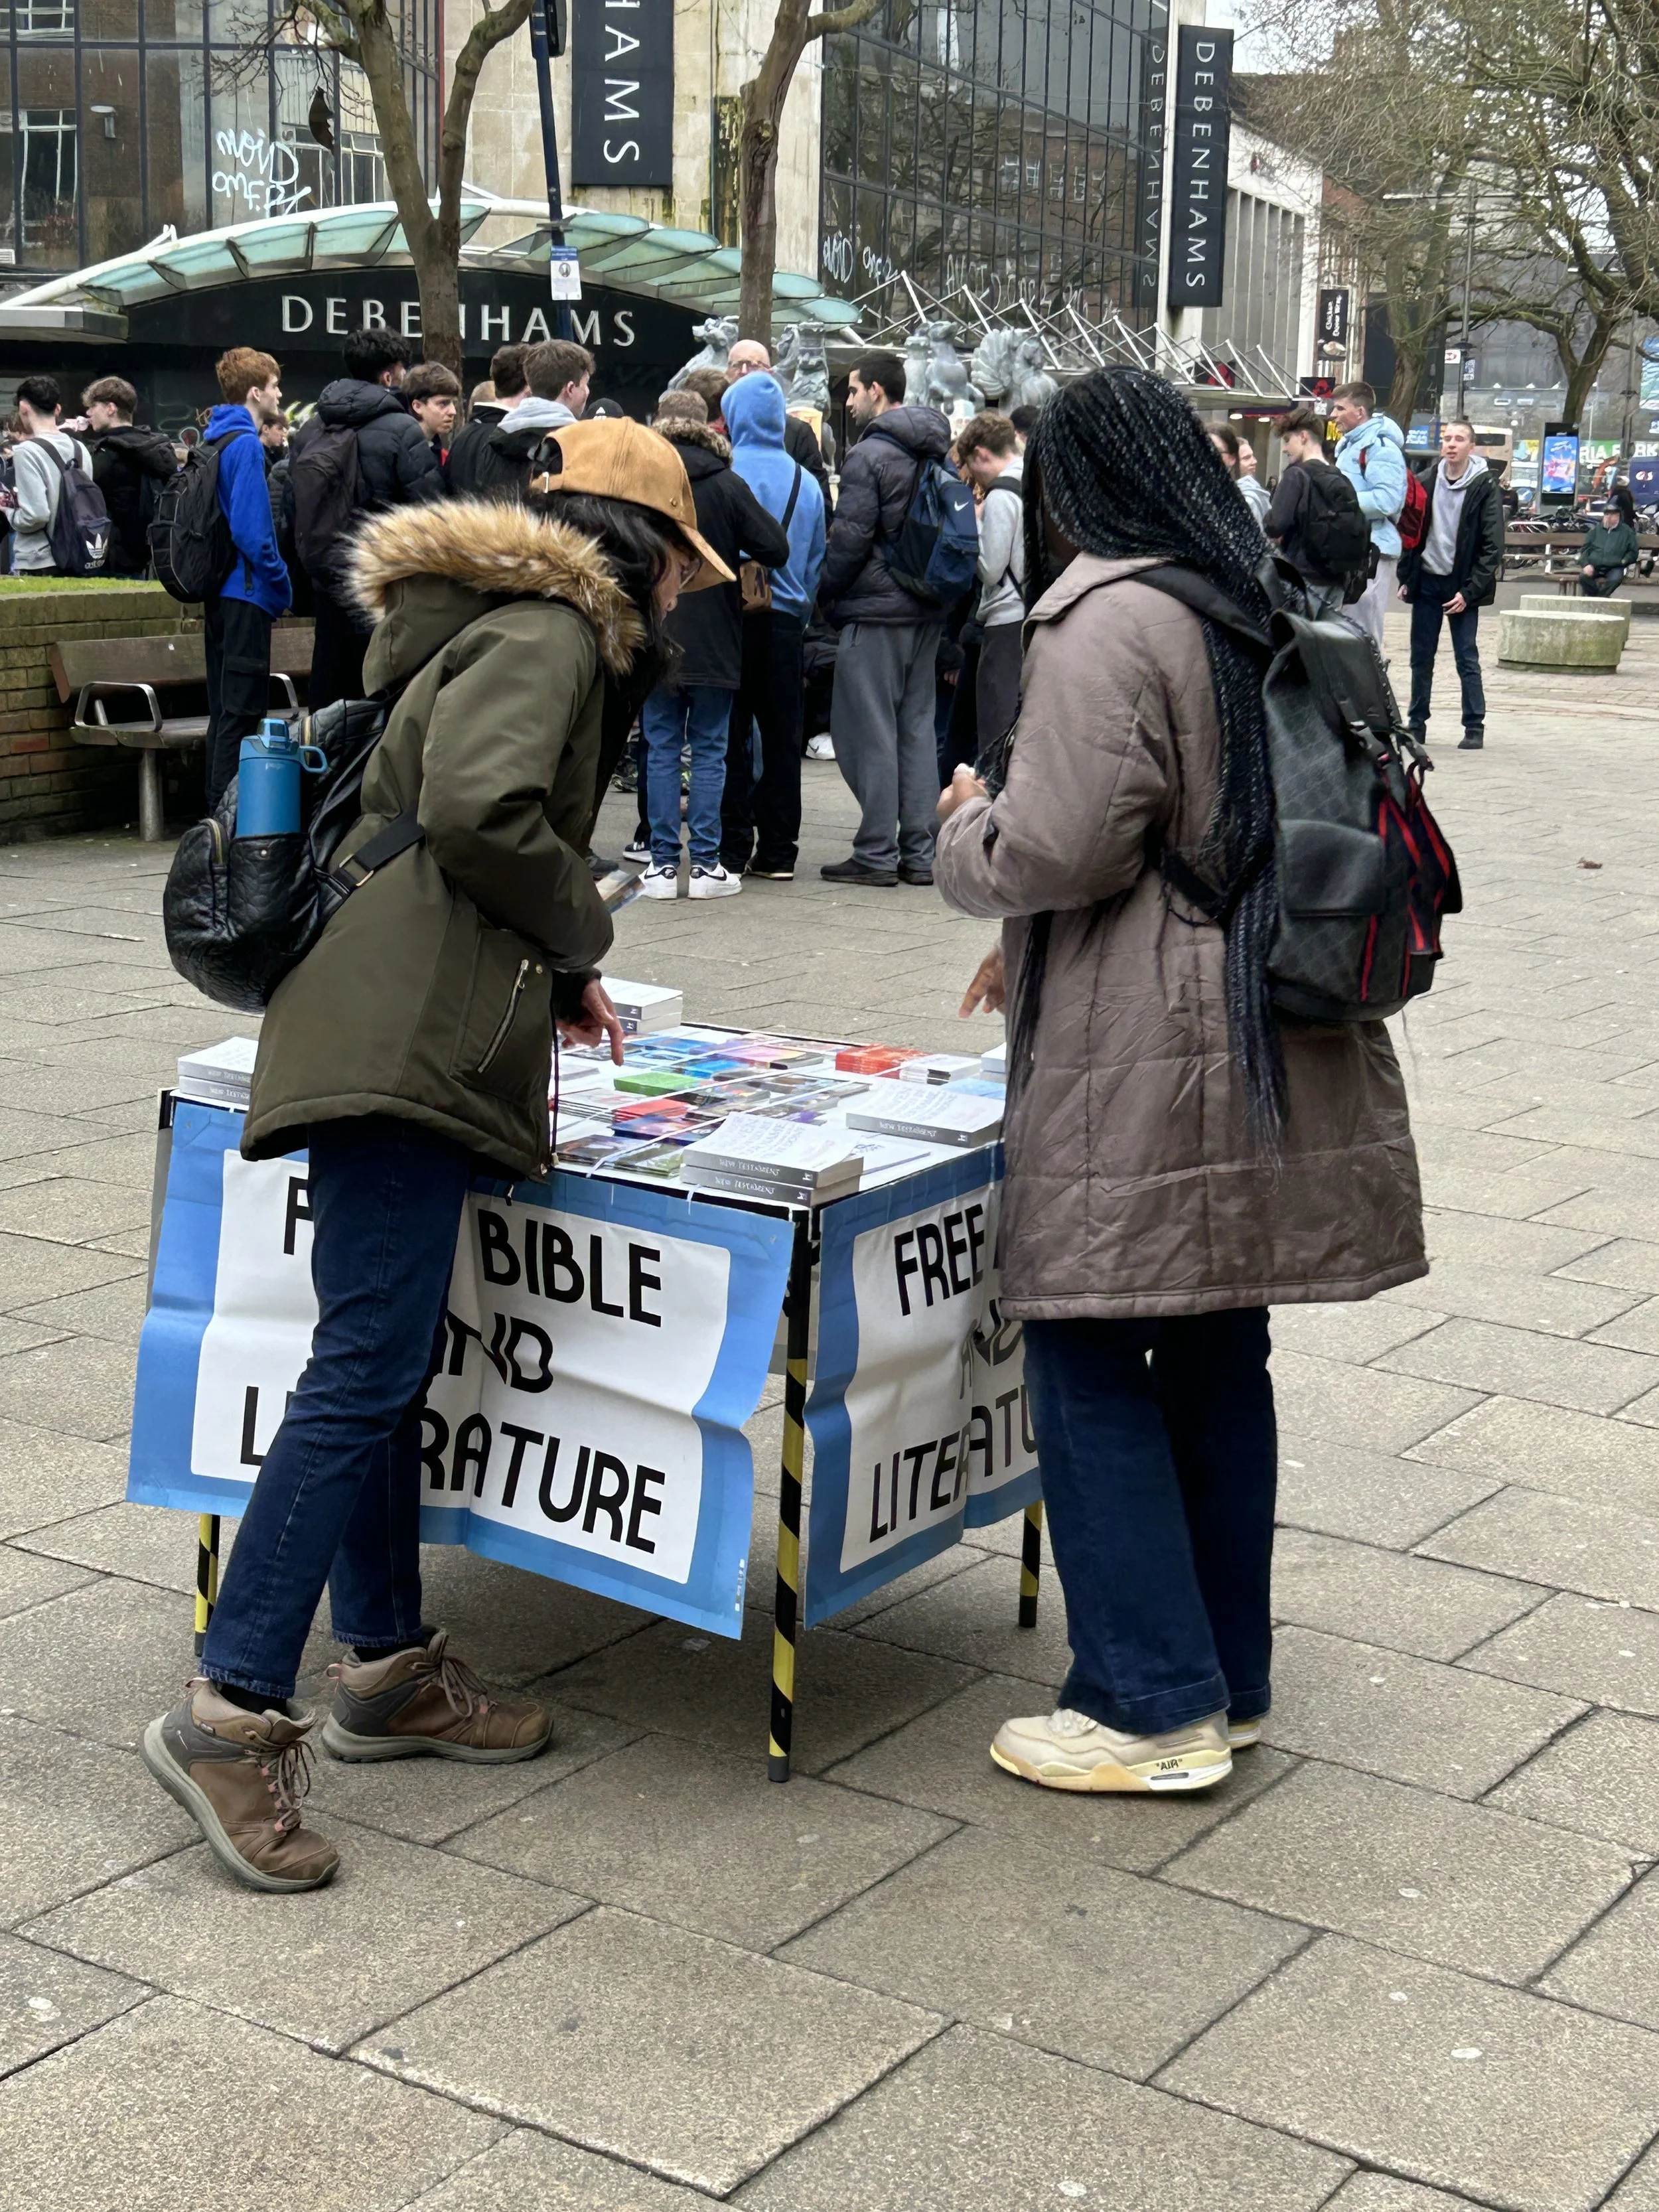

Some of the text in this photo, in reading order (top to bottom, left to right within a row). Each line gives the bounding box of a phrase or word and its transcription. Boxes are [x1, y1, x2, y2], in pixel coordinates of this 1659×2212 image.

[1186, 42, 1215, 287] DEBENHAMS
[478, 1209, 662, 1327] BIBLE
[894, 1204, 985, 1317] FREE
[240, 1385, 666, 1554] LRATURE
[870, 1384, 1039, 1544] LITERATU
[1155, 1758, 1183, 1771] "AIR"
